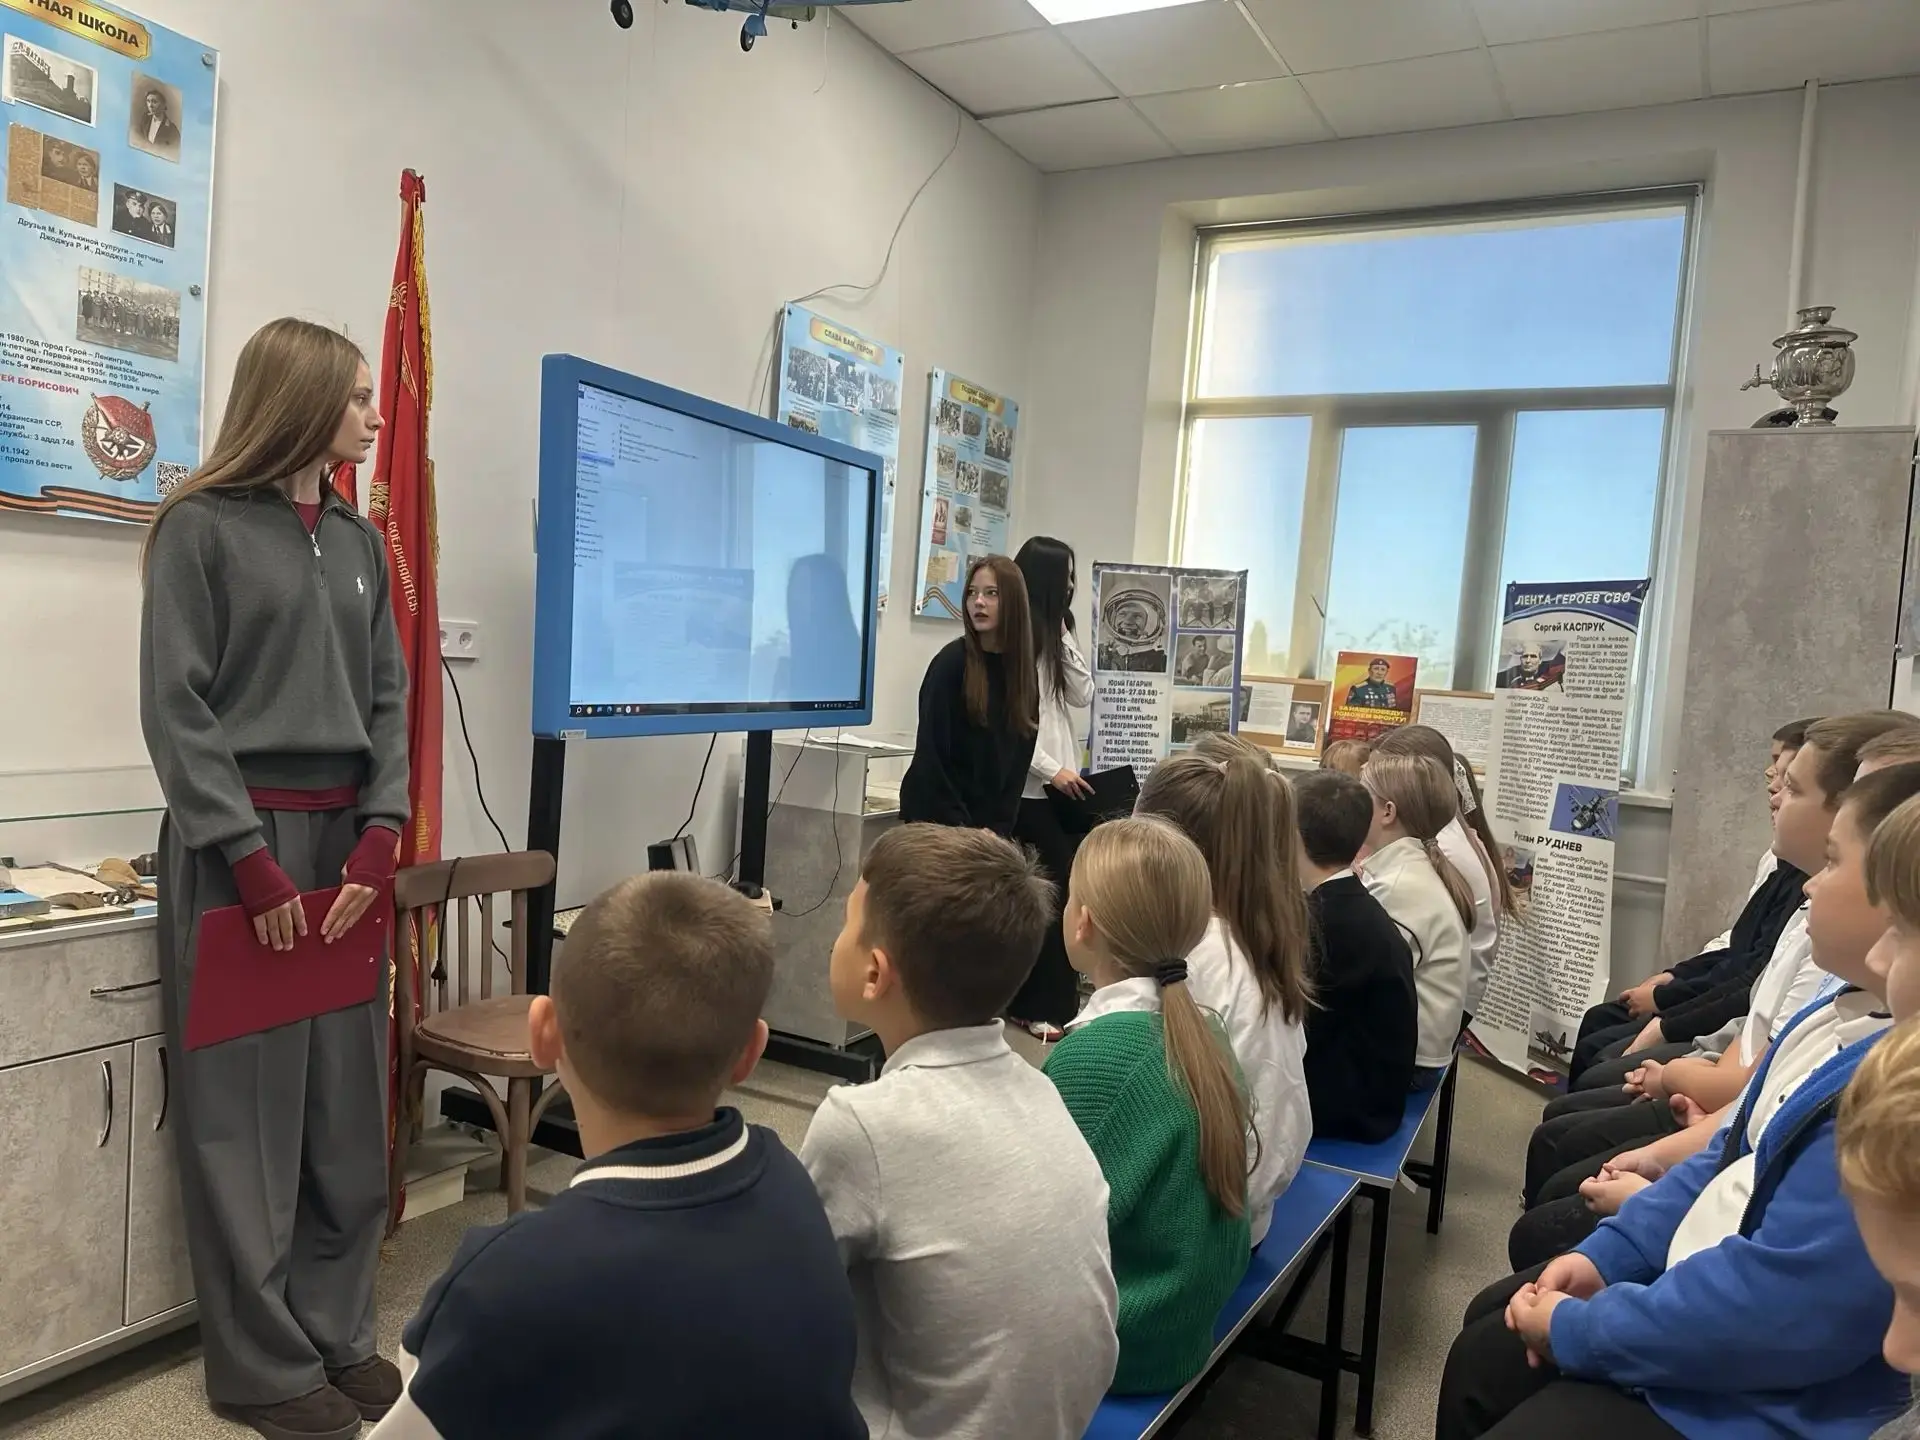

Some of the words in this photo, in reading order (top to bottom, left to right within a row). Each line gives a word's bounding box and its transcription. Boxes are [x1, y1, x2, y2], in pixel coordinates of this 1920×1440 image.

[29, 0, 73, 20] НАЯ
[78, 12, 139, 48] ШКОЛА
[18, 217, 47, 231] Друзья
[48, 222, 57, 232] М.
[101, 242, 129, 256] супруги
[40, 232, 74, 248] Джоджуа
[7, 333, 25, 343] 1980
[26, 338, 40, 348] год
[41, 341, 63, 352] город
[65, 345, 87, 357] Герой
[94, 351, 133, 368] Ленинград
[43, 349, 71, 362] Первой
[73, 356, 103, 368] женской
[3, 350, 24, 360] была
[26, 354, 78, 370] организована
[16, 361, 29, 370] 5-я
[30, 365, 62, 376] женская
[0, 374, 15, 382] ЕЙ
[18, 377, 79, 395] БОРИСОВИЧ
[5, 456, 34, 465] пропал
[36, 459, 49, 467] без
[1515, 594, 1551, 605] ЛЕНТА
[1555, 593, 1600, 604] ГЕРОЕВ
[1604, 592, 1631, 603] СВО
[1534, 622, 1561, 634] Сергей
[1563, 622, 1605, 631] КАСПРУК
[1108, 679, 1125, 687] Юрий
[1126, 679, 1153, 687] ГАГАРИН
[1514, 831, 1535, 844] Руслан
[1537, 836, 1583, 852] РУДНЕВ
[1557, 985, 1569, 993] Это
[1571, 989, 1588, 998] были
